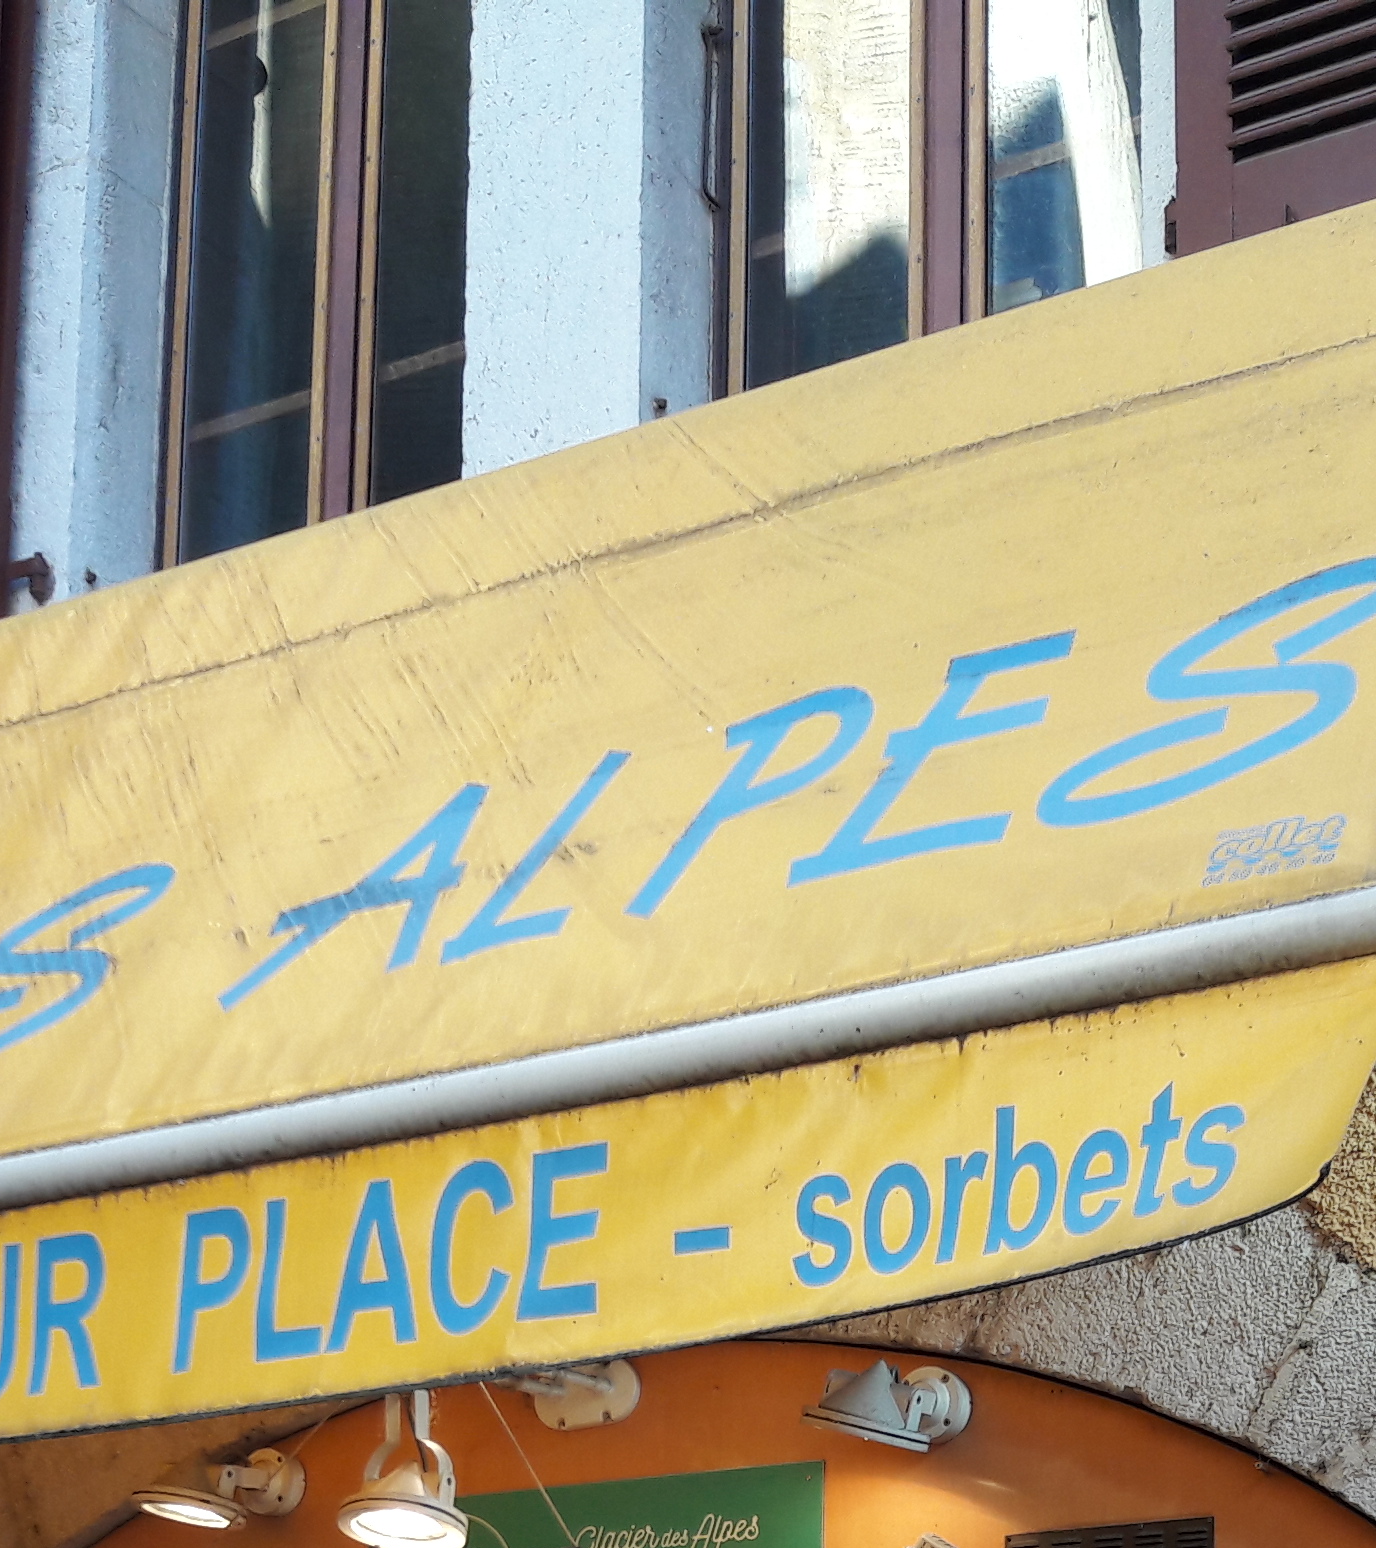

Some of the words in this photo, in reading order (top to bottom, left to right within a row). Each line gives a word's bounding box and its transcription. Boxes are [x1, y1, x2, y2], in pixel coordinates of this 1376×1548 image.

[173, 1141, 608, 1375] PLACE
[792, 1082, 1247, 1288] sorbets
[661, 1528, 689, 1548] des
